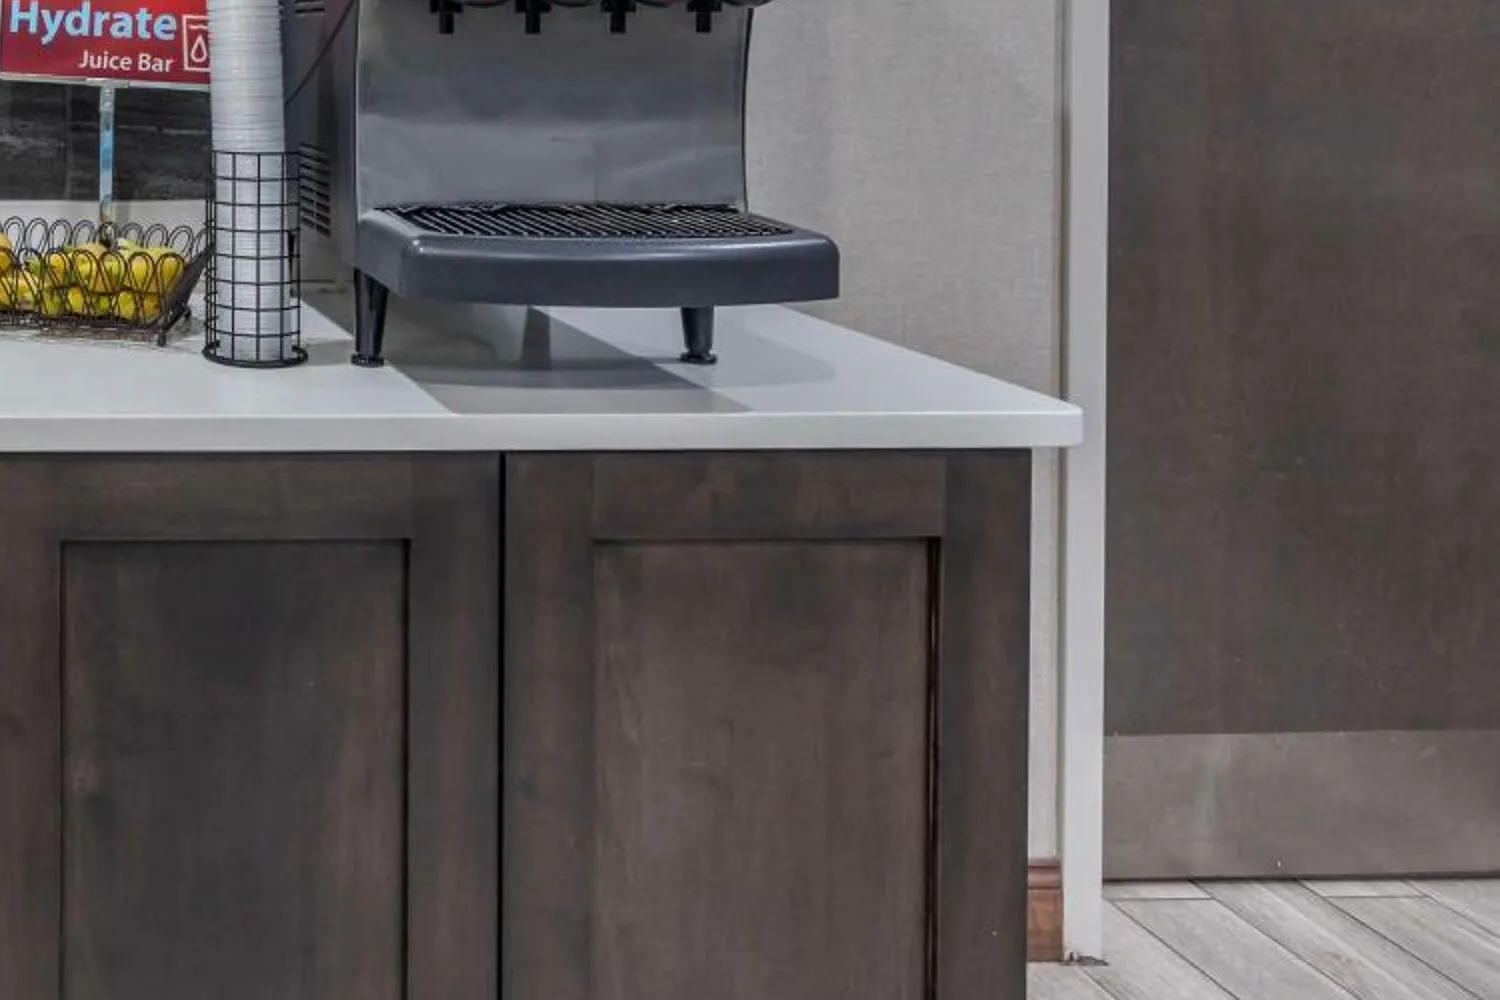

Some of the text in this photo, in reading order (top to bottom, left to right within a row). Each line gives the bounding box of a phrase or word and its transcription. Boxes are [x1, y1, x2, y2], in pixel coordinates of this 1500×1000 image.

[8, 0, 178, 46] Hydrate
[77, 49, 173, 73] Juice Bar
